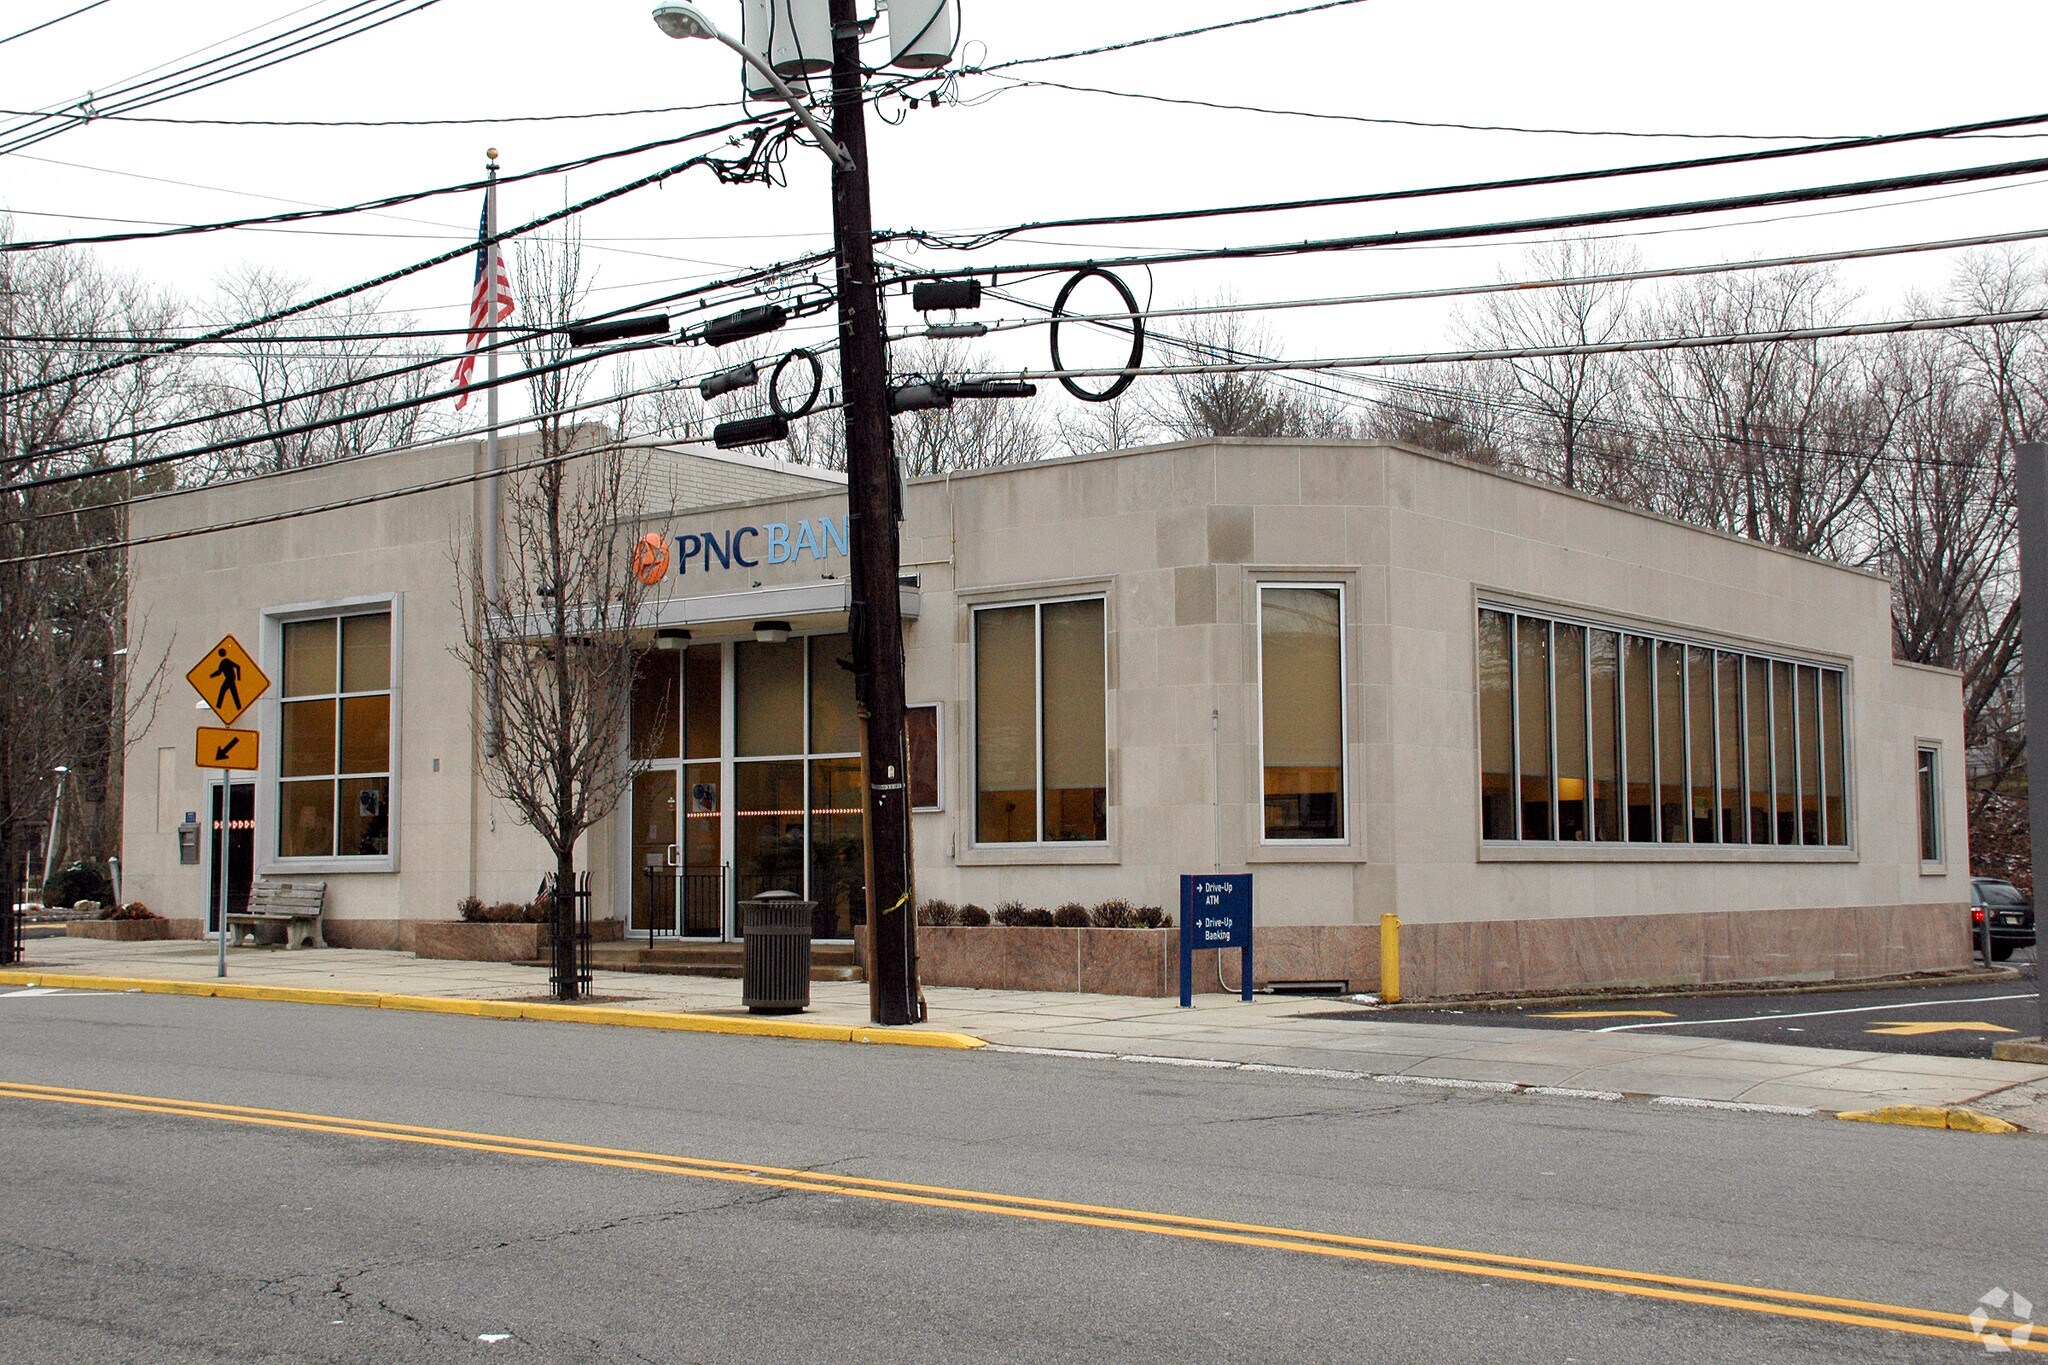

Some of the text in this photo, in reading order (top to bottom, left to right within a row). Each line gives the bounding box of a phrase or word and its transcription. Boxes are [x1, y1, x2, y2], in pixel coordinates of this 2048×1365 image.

[675, 515, 849, 574] PNC BAN
[1205, 882, 1233, 894] Drive-Up
[1205, 895, 1220, 905] ATM
[1205, 917, 1233, 929] Drive-Up
[1205, 930, 1231, 942] Banking
